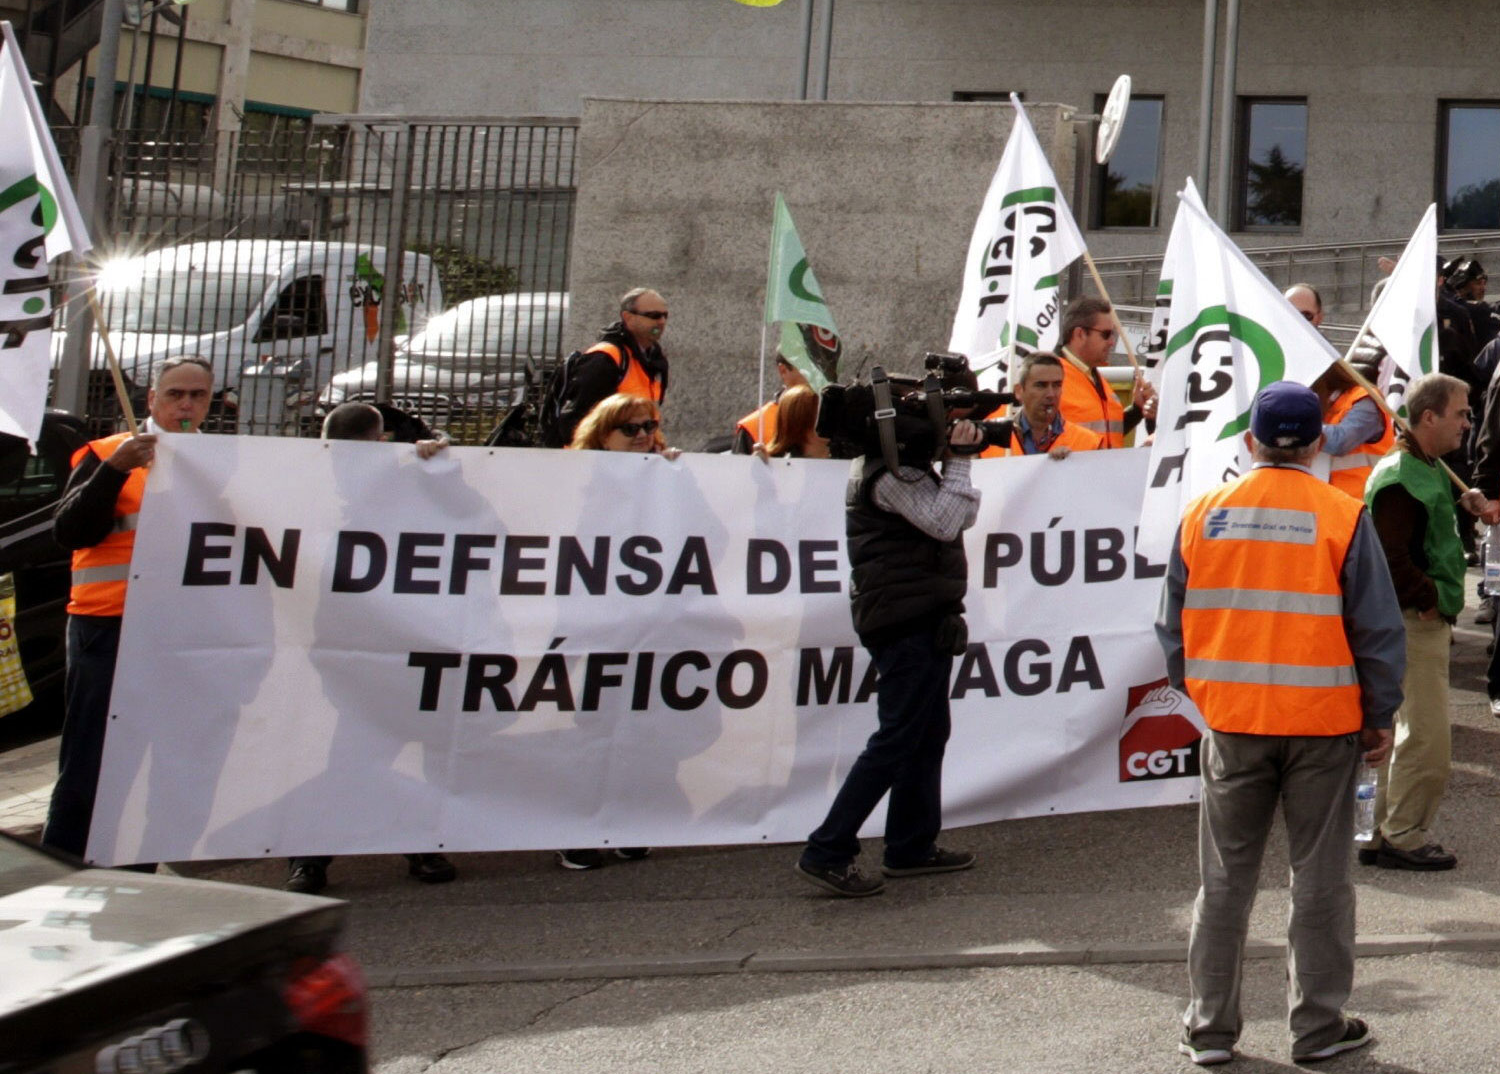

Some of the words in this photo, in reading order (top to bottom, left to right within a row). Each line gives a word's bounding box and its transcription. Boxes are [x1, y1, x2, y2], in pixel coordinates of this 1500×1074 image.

[182, 521, 302, 589] EN
[331, 530, 719, 597] DEFENSA
[745, 538, 843, 595] DE
[982, 516, 1168, 589] PÚBL
[407, 636, 770, 712] TRÁFICO
[795, 635, 1106, 706] MAGA
[1126, 747, 1192, 776] CGT
